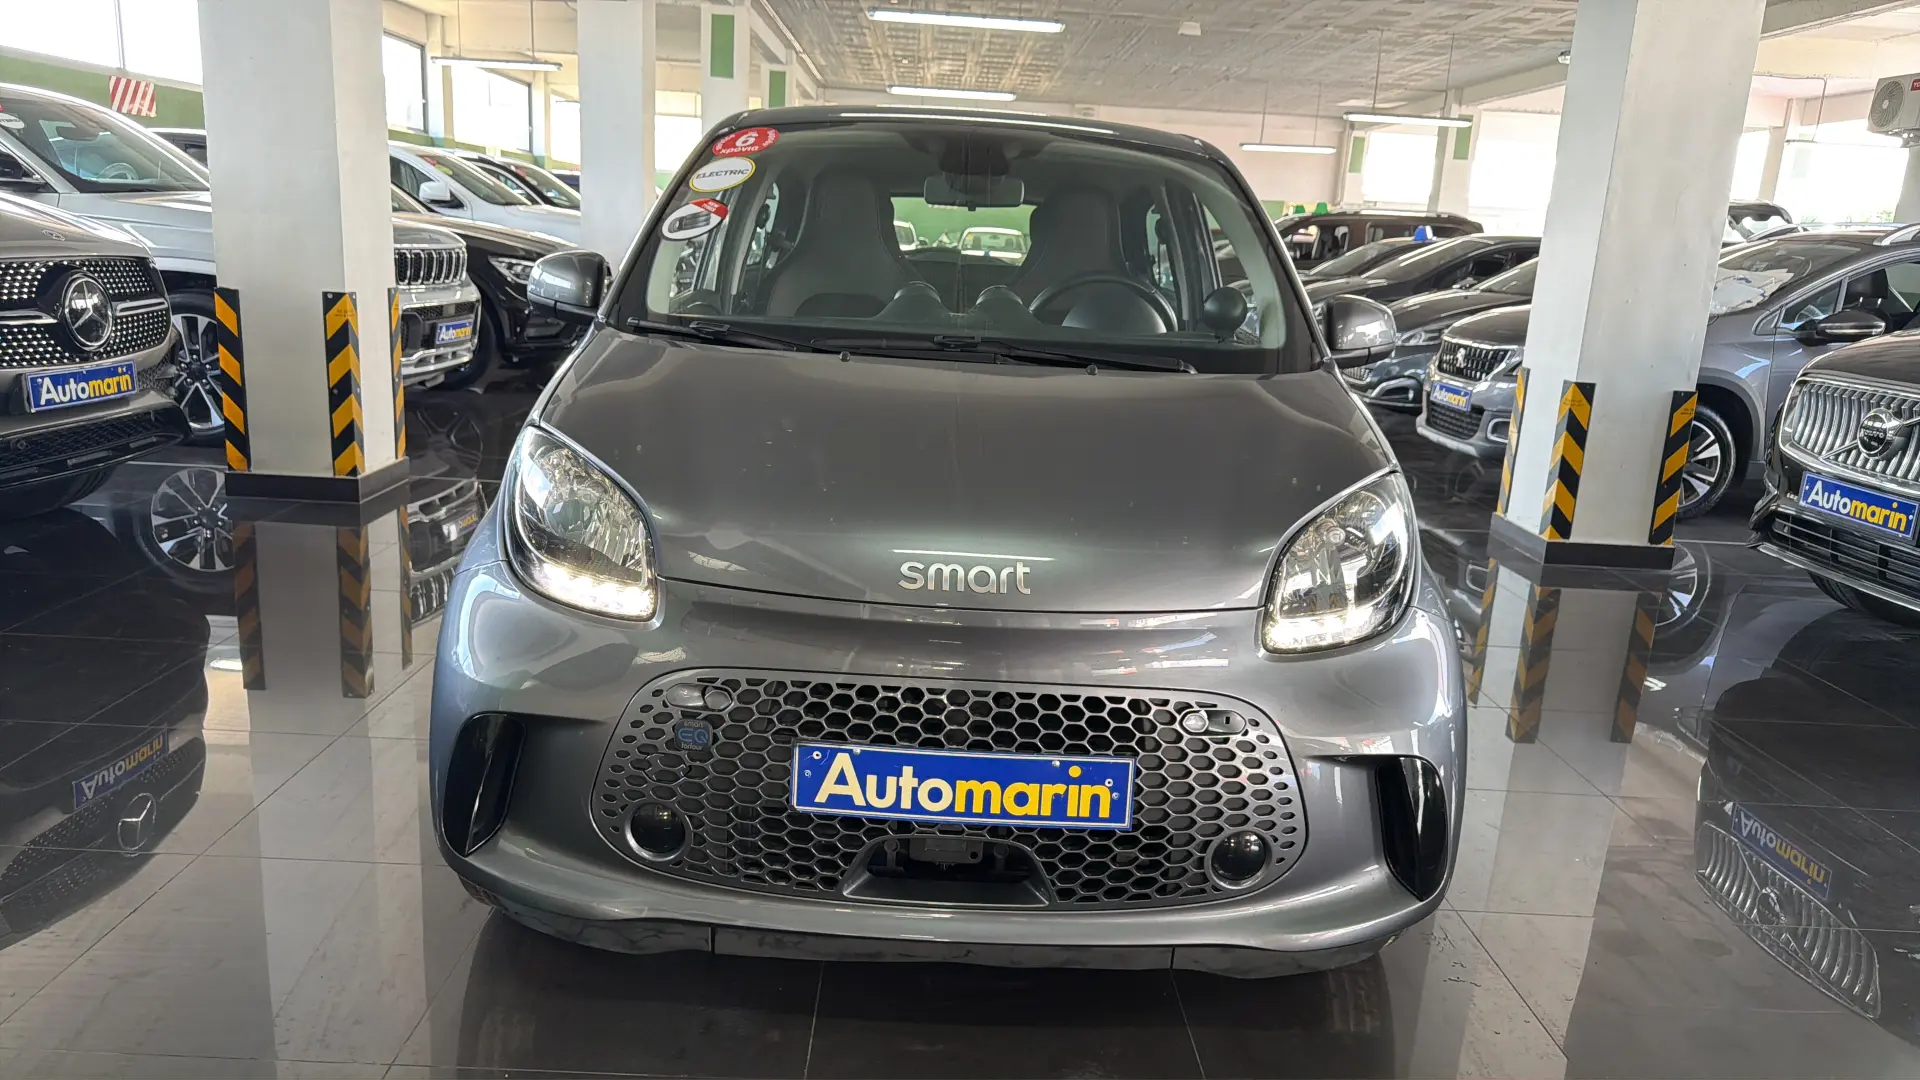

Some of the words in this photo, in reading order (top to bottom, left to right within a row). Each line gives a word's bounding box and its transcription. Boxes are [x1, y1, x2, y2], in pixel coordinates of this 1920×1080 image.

[735, 131, 759, 147] 6
[696, 169, 749, 179] ELECTRIC
[40, 366, 133, 406] Automarin
[1807, 480, 1908, 532] Automarin
[898, 561, 1031, 595] smart
[678, 728, 708, 743] EQ
[684, 720, 704, 728] smart
[814, 752, 1111, 818] Automarin
